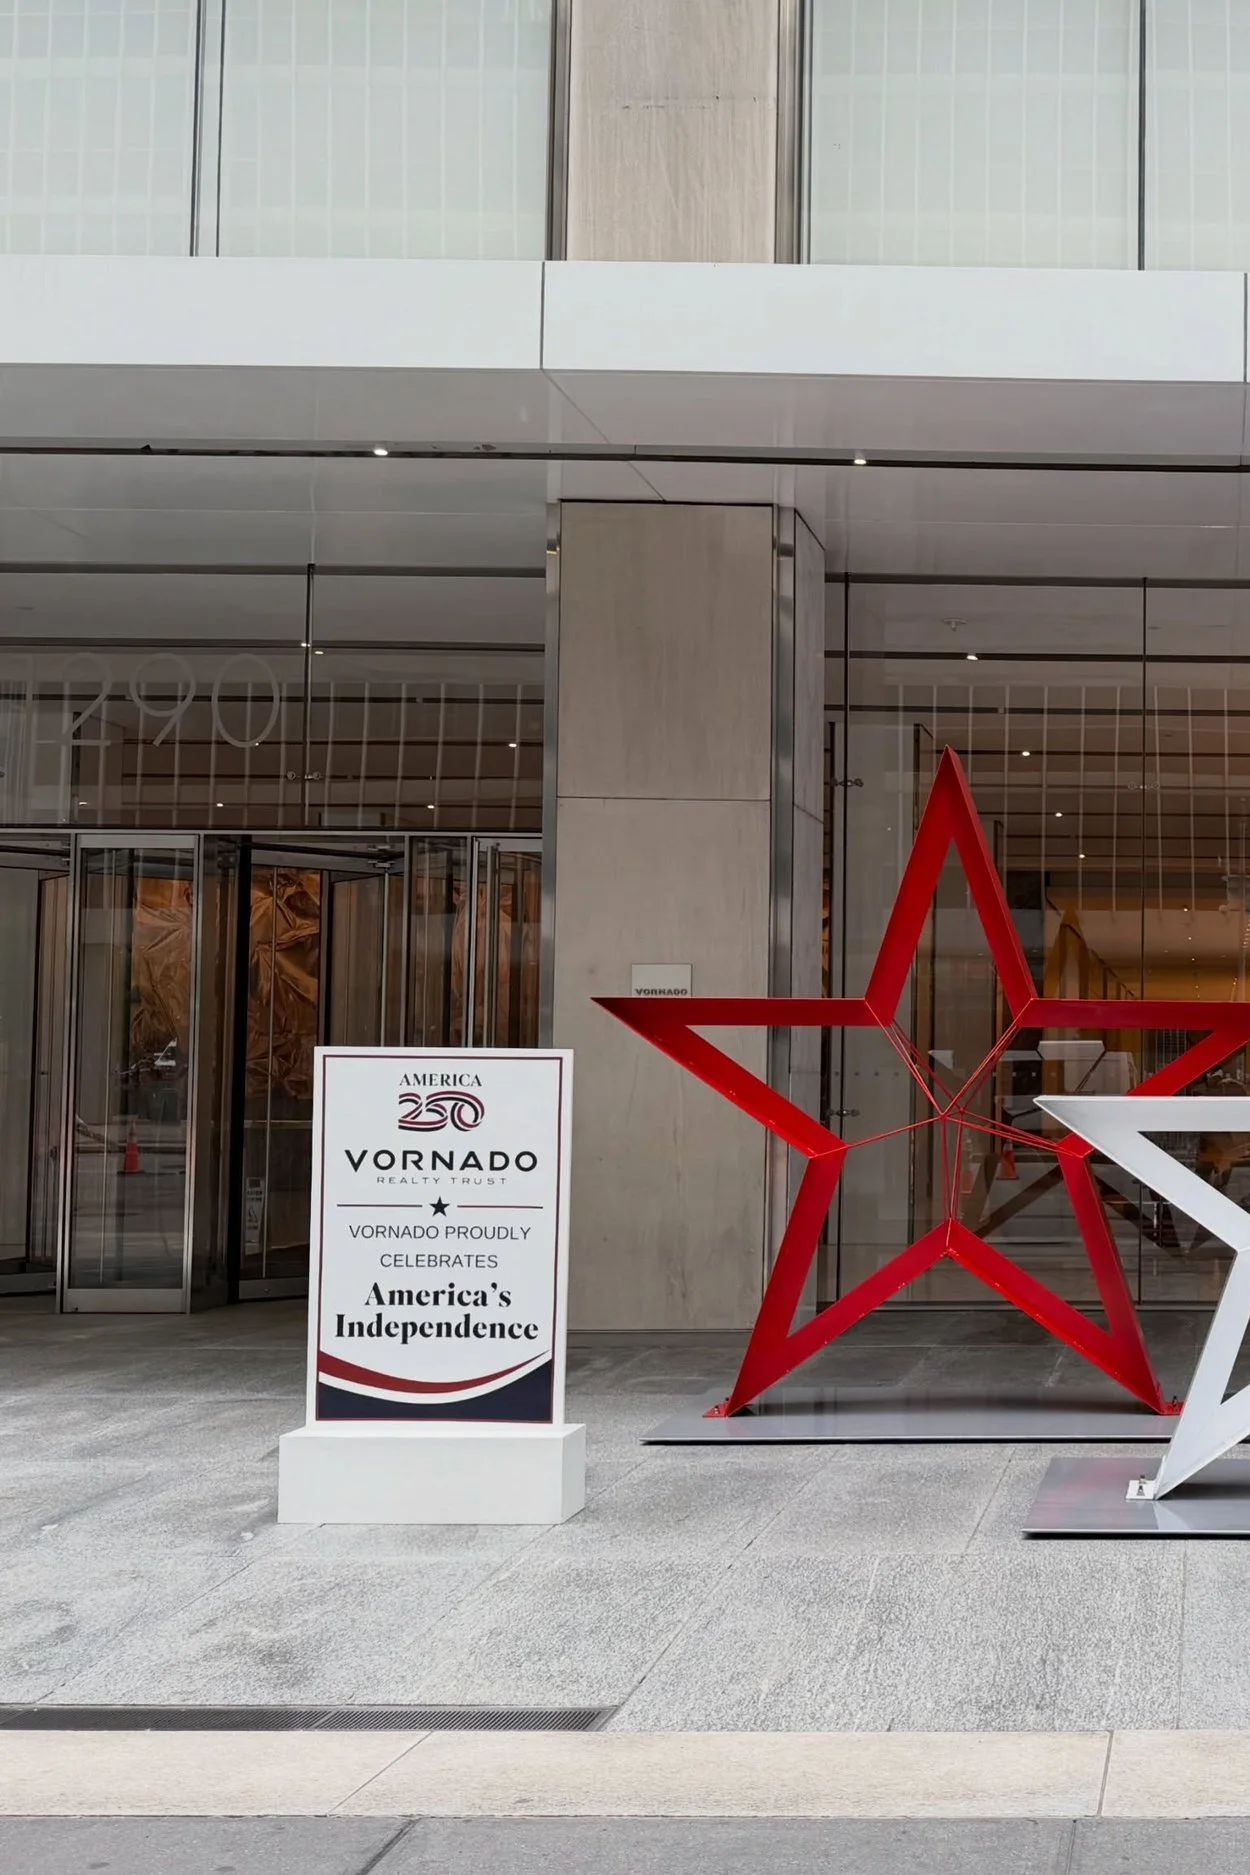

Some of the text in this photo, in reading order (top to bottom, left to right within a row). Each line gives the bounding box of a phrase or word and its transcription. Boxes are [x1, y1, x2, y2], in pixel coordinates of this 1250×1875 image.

[59, 653, 280, 748] 290
[399, 1073, 483, 1087] AMERICA
[397, 1090, 486, 1133] 250
[344, 1149, 538, 1173] VORNADO
[376, 1176, 508, 1186] REALTY TRUST
[349, 1224, 532, 1241] VORNADO PROUDLY
[379, 1253, 499, 1269] CELEBRATES
[364, 1281, 512, 1308] America’s
[334, 1312, 539, 1345] Independence
